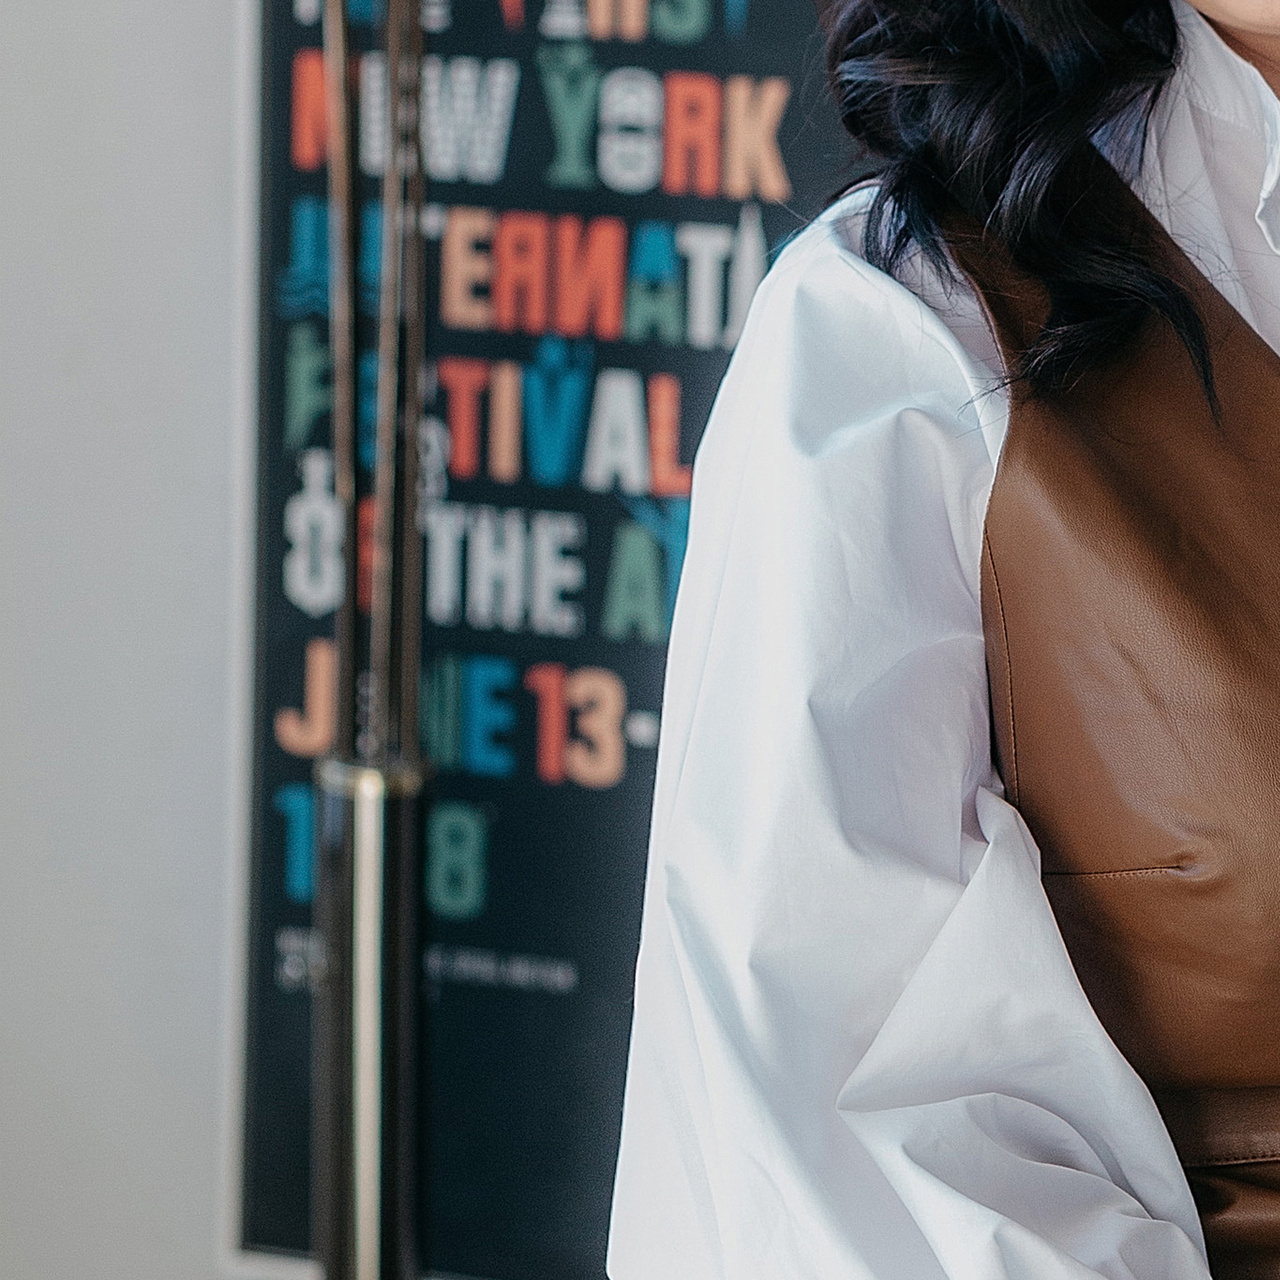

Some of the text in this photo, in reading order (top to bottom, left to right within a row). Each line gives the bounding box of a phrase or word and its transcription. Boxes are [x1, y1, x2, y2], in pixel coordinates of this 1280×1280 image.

[535, 42, 794, 202] YORK
[415, 498, 585, 638] THE
[274, 635, 516, 776] JNE
